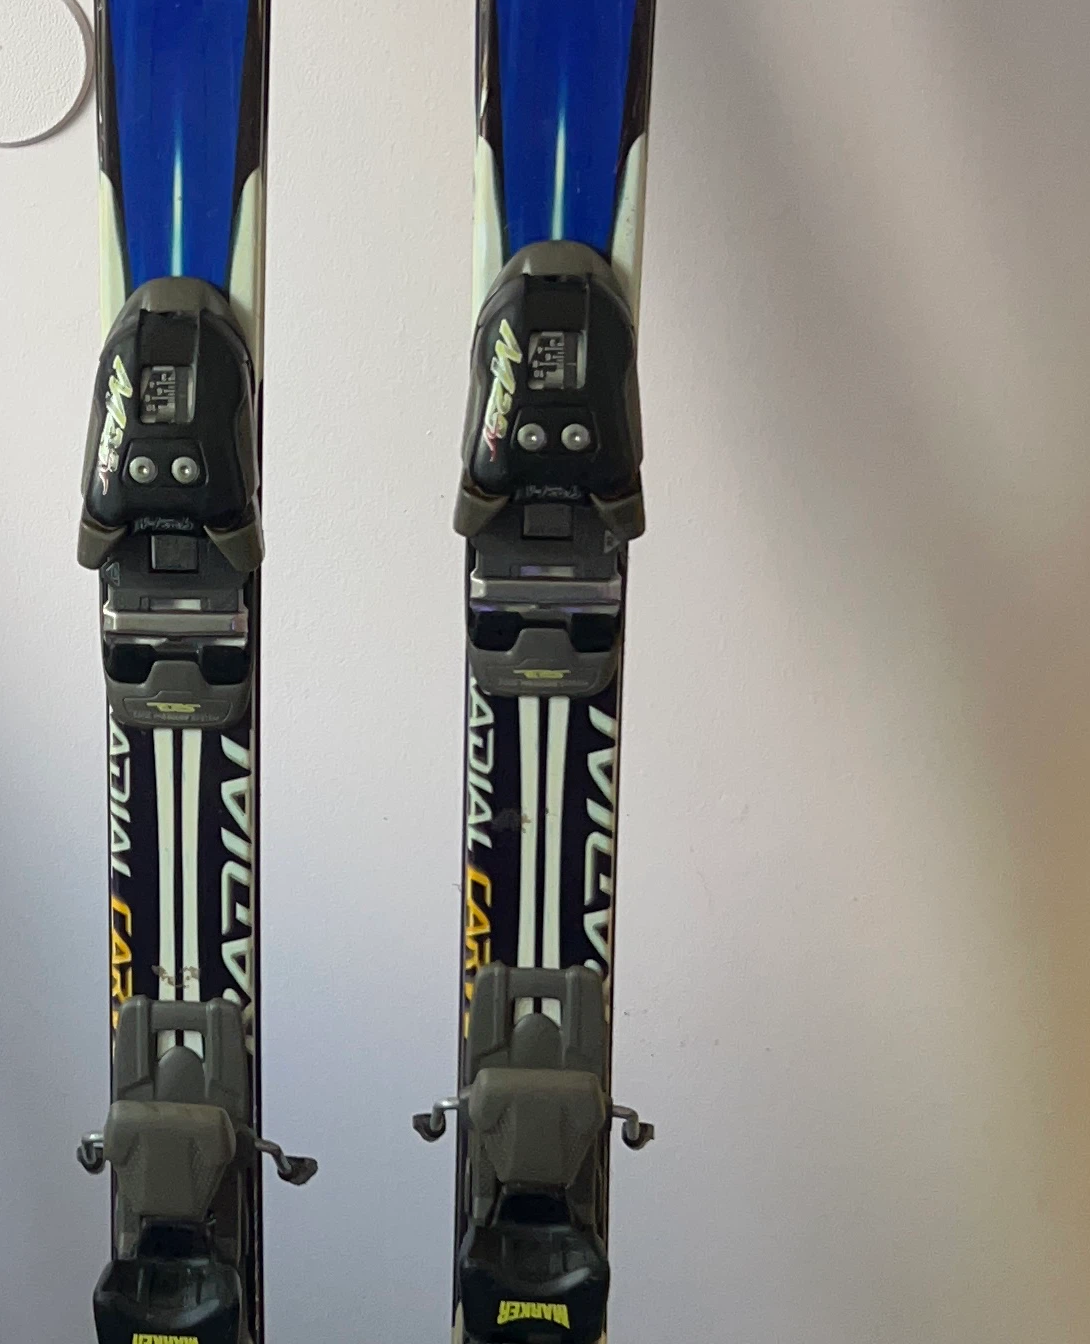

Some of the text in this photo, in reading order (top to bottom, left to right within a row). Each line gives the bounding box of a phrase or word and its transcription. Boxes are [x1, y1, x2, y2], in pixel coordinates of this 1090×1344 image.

[110, 706, 132, 1034] ADIAL CAR
[220, 734, 252, 1054] ADIAL
[465, 678, 494, 1040] ADIAL CAR
[584, 705, 617, 976] ADIAL
[496, 1300, 570, 1329] MARKER
